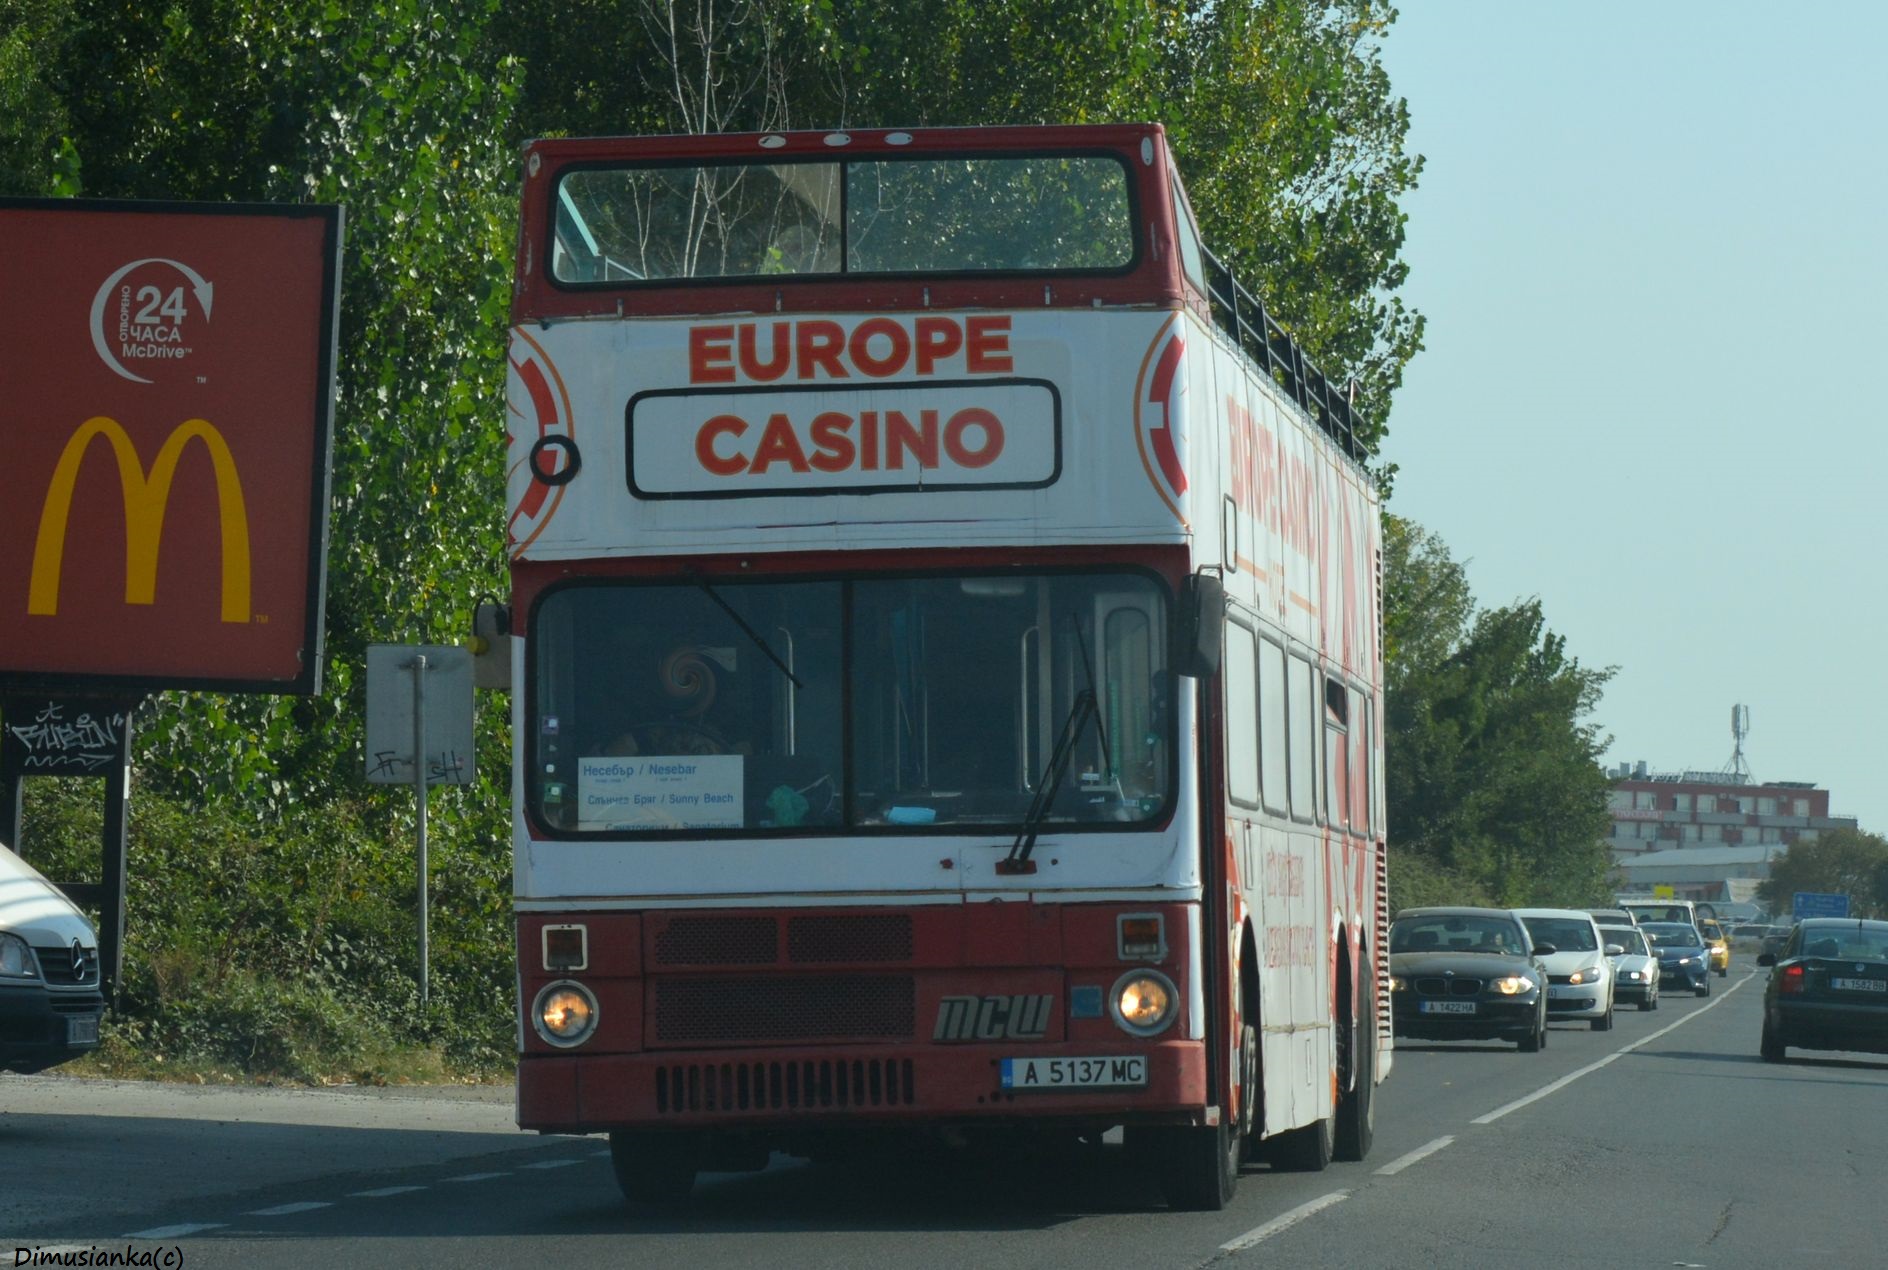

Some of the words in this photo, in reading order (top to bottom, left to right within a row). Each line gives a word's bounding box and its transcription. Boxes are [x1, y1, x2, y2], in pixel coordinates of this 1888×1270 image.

[119, 285, 131, 342] ОТВОРЕНО
[134, 285, 188, 325] 24
[130, 325, 182, 342] ЧАСА
[688, 315, 1014, 384] EUROPE
[695, 407, 1006, 476] CASINO
[1226, 393, 1278, 535] EUROPE
[583, 764, 634, 778] Несебър
[649, 763, 697, 776] Nesebar
[634, 794, 656, 806] Бряг
[669, 793, 699, 806] Sunny
[704, 793, 734, 804] Beach
[1024, 1061, 1039, 1084] A
[1050, 1060, 1106, 1083] 5137
[1111, 1059, 1142, 1082] MC
